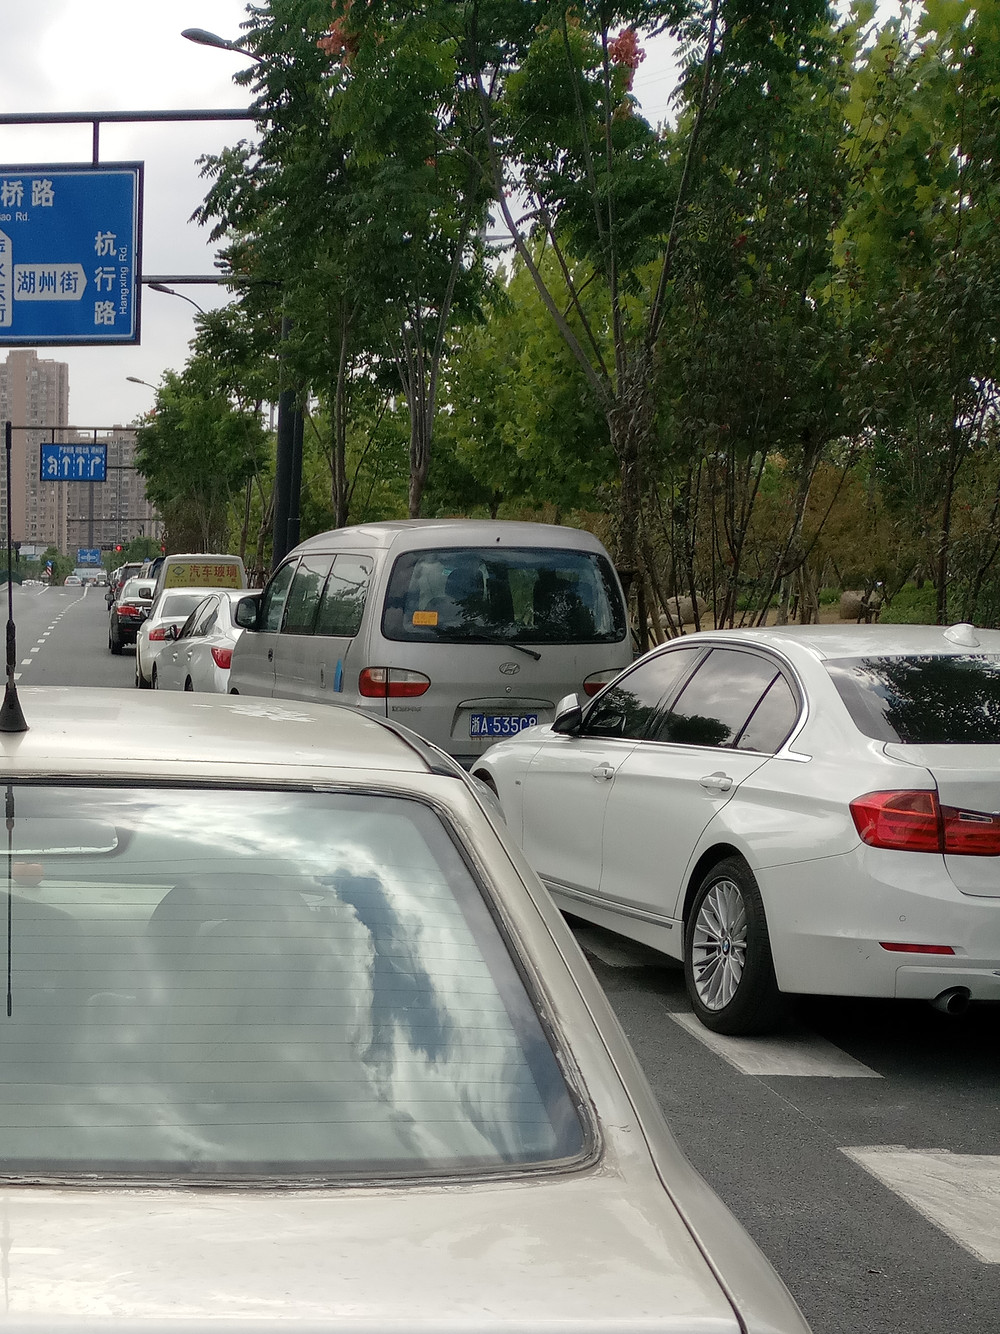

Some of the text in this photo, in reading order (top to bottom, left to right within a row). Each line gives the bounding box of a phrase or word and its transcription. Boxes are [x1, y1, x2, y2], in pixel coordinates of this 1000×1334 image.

[15, 211, 30, 222] Rd.
[16, 270, 79, 295] 湖州街
[94, 231, 118, 326] 杭行路
[118, 244, 130, 315] Hangxing Rd.
[189, 564, 237, 578] 汽车玻璃
